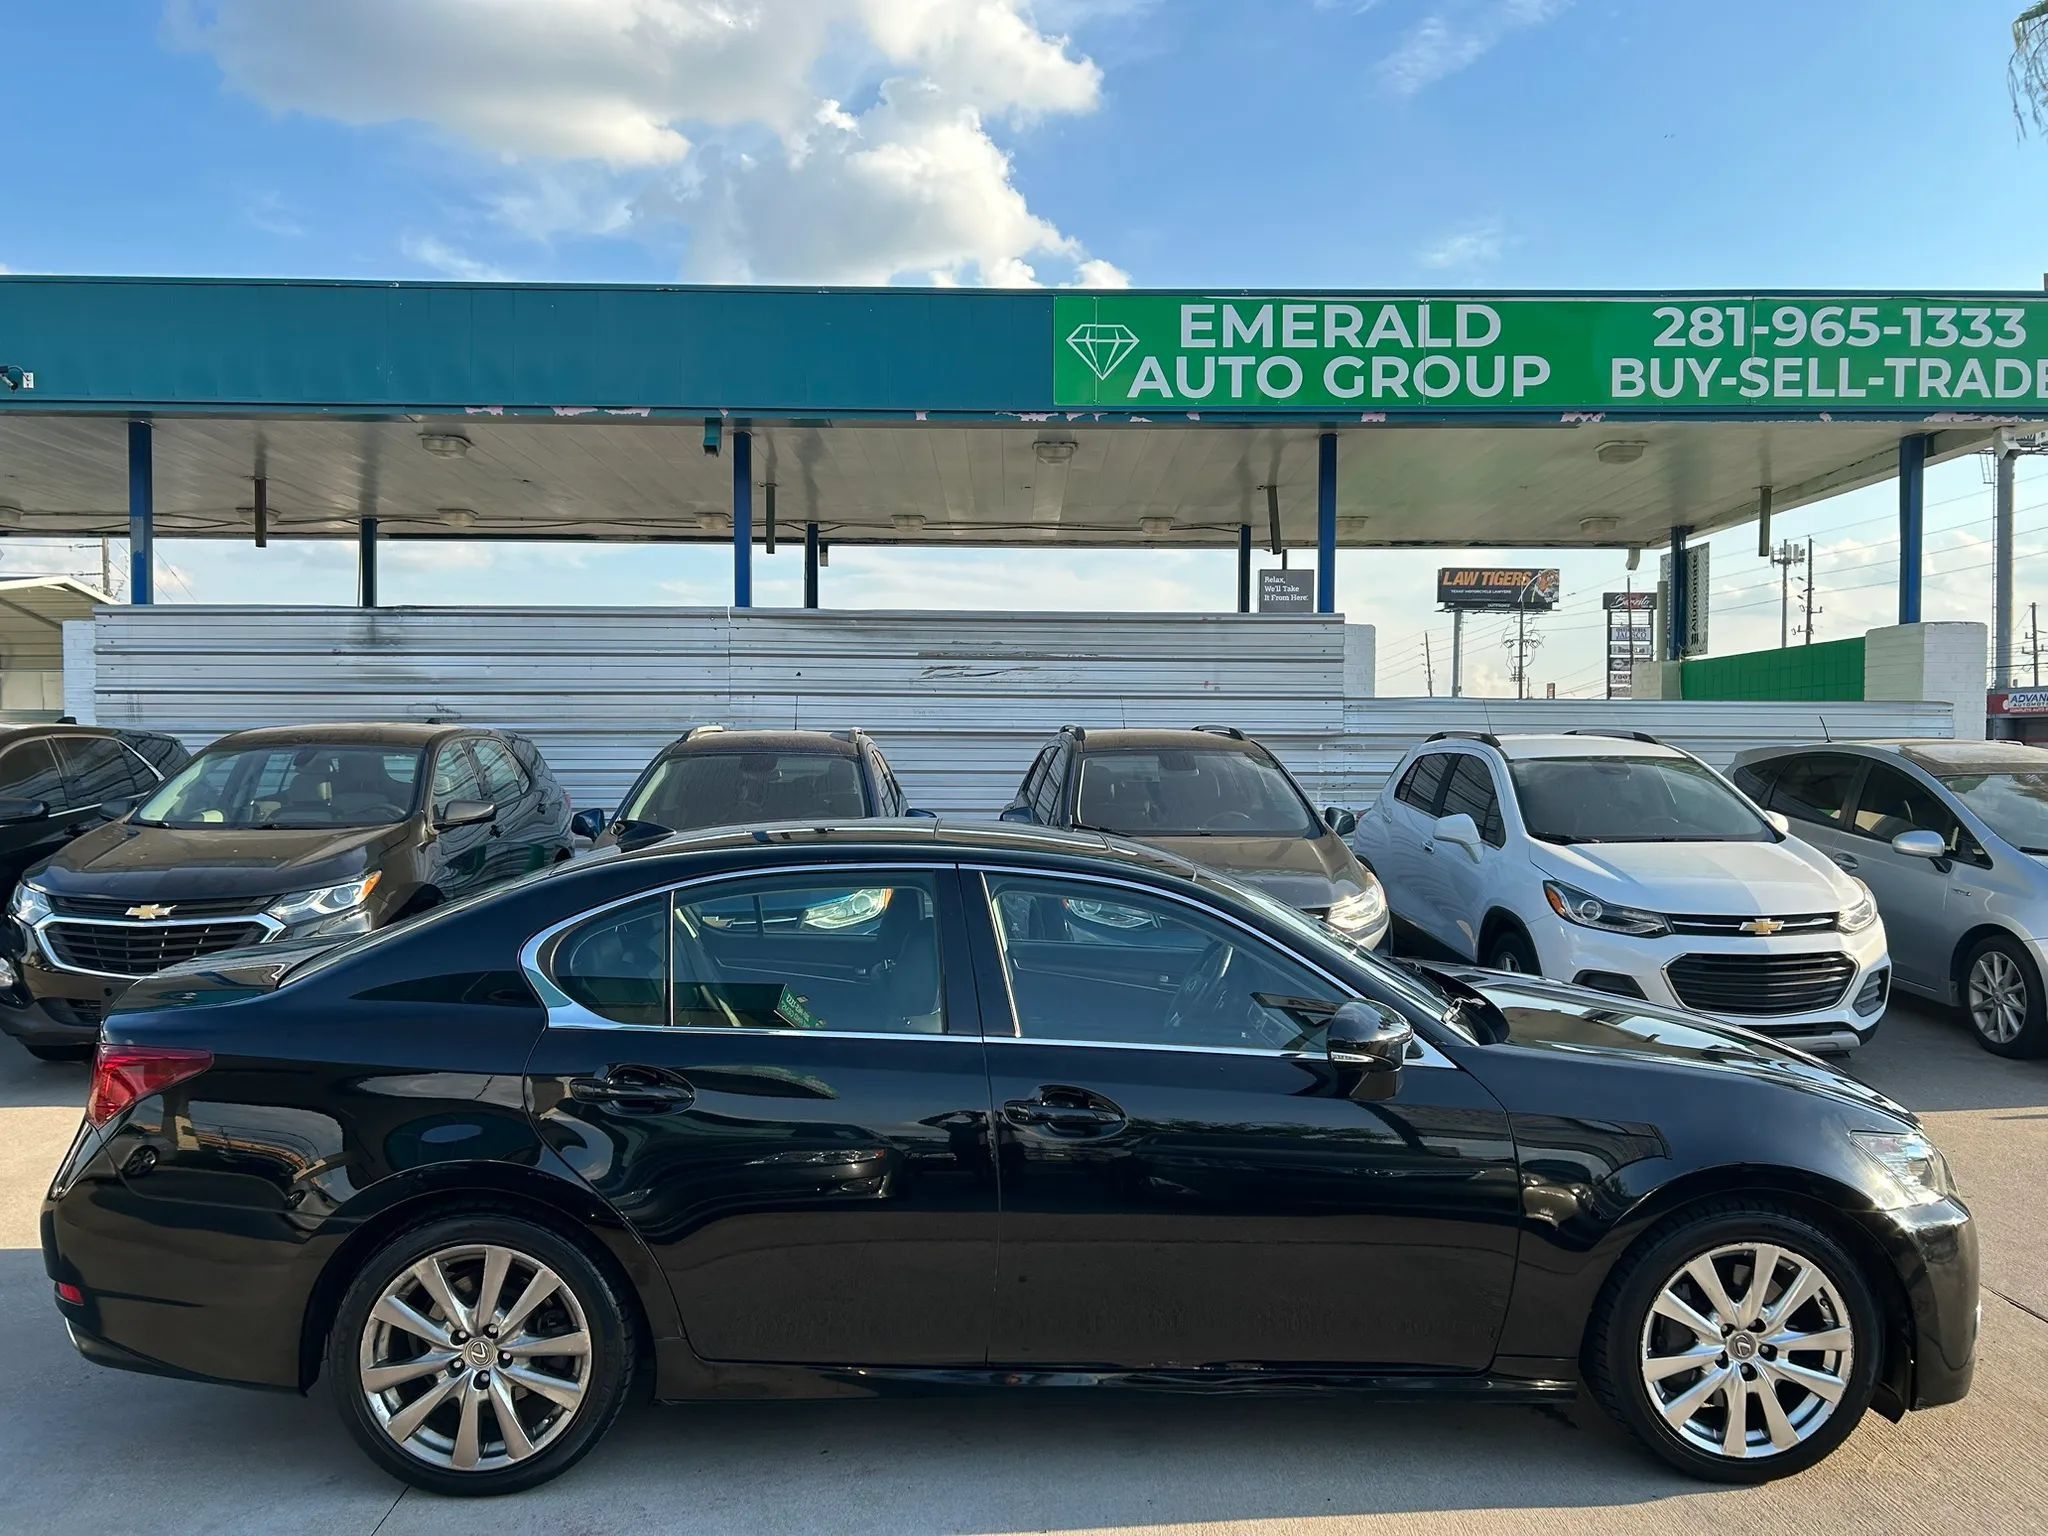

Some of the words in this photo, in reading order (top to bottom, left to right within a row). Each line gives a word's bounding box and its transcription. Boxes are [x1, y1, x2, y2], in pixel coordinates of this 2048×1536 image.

[1180, 304, 1501, 348] EMERALD
[1652, 307, 2026, 347] 281-965-1333
[1126, 355, 1303, 399] AUTO
[1324, 355, 1551, 399] GROUP
[1612, 357, 2048, 399] BUY-SELL-TRADE
[1264, 576, 1286, 584] Relax,
[1442, 571, 1480, 586] LAW
[1481, 571, 1532, 587] TIGERS
[1616, 631, 1647, 641] JALSCO
[2010, 694, 2048, 703] ADVAN
